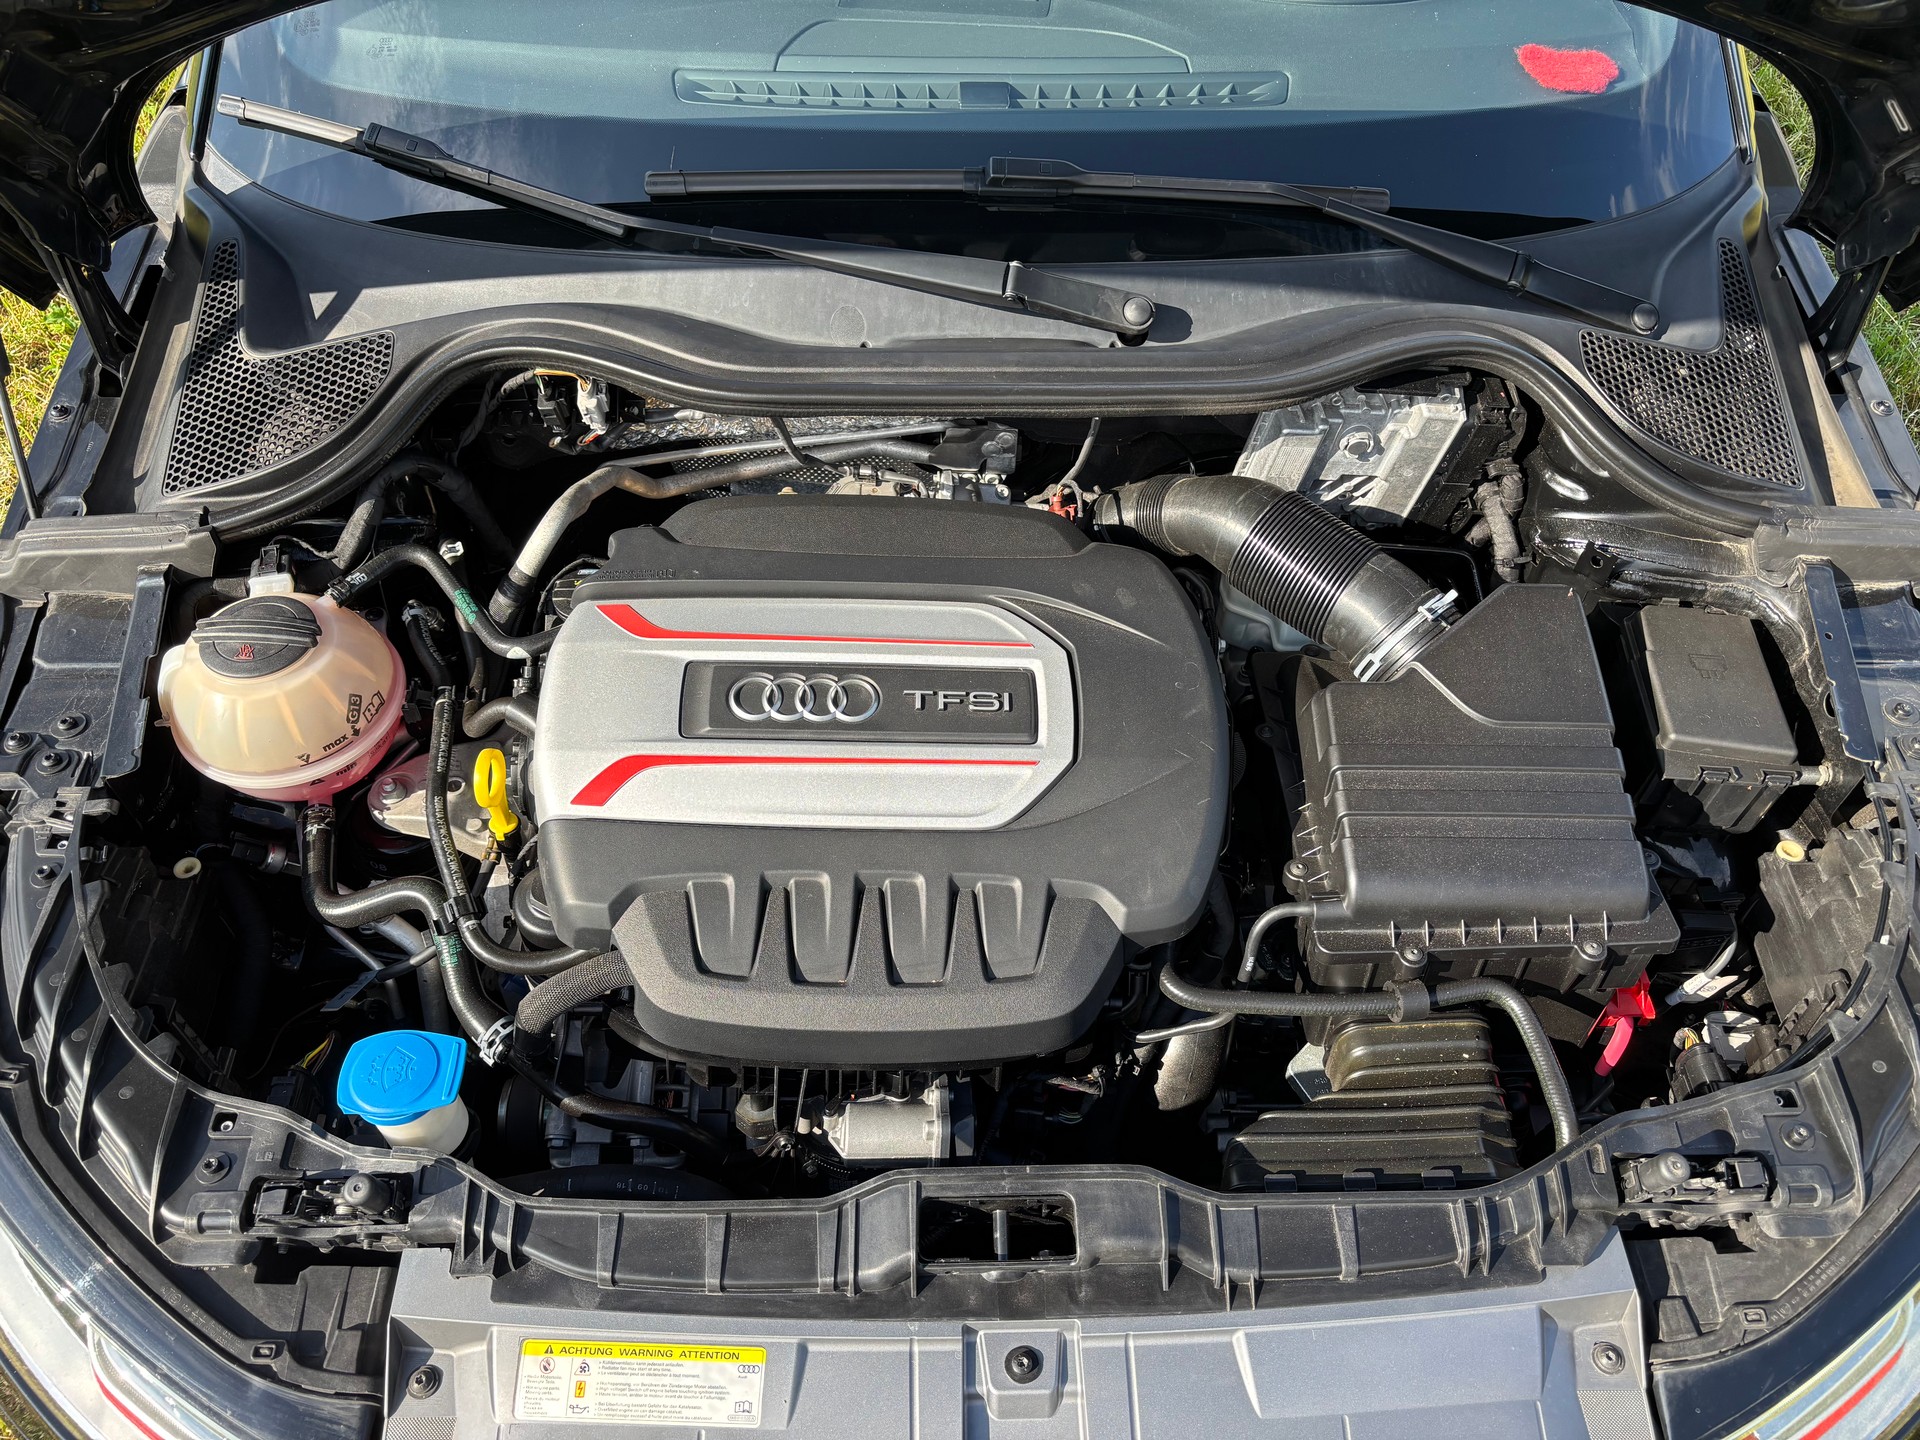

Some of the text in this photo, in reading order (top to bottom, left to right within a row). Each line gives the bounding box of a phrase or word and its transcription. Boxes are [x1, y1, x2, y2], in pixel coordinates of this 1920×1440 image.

[349, 696, 360, 721] G13
[903, 690, 1012, 712] TFSI
[323, 734, 349, 752] max
[335, 762, 357, 776] min
[560, 1346, 740, 1360] ACHTUNG WARNING ATTENTION
